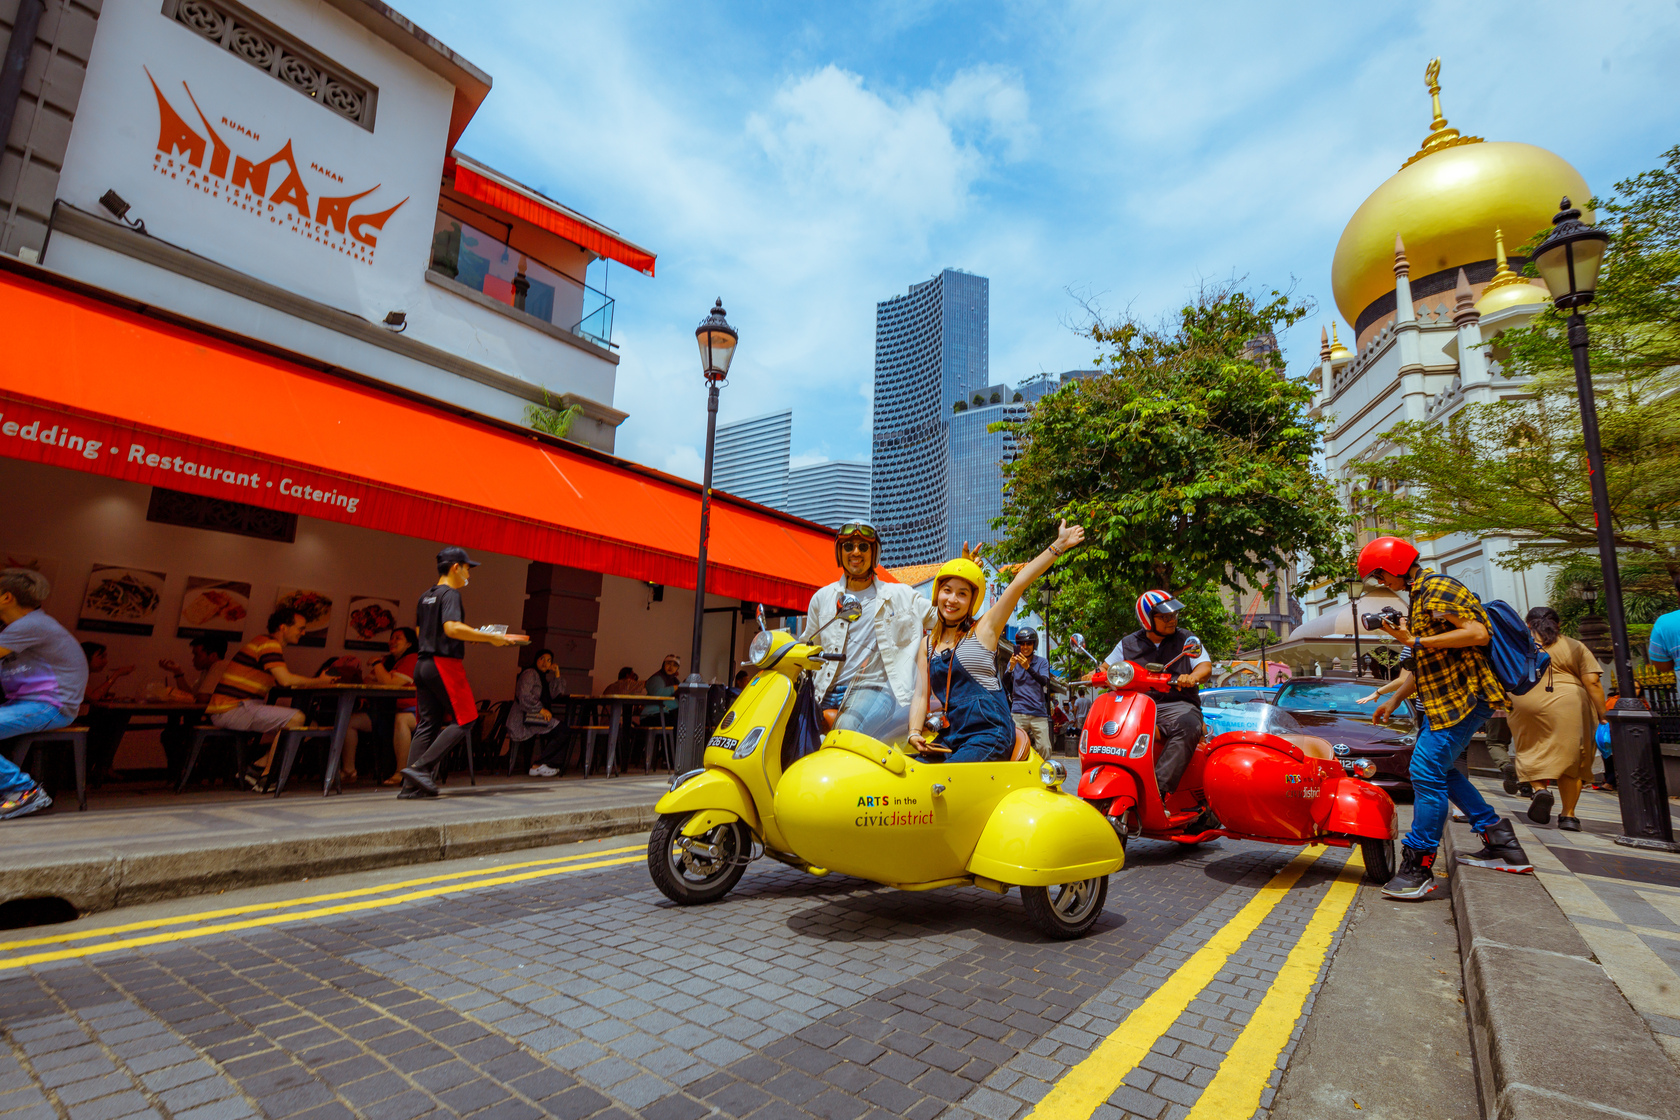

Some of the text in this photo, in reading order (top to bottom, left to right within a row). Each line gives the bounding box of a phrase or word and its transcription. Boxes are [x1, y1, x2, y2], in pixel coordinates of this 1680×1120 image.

[143, 64, 410, 249] MINANG
[221, 116, 260, 142] RUMAH
[153, 163, 374, 266] THE TRUE TASTE OF MINANGKABAU
[154, 153, 274, 213] ESTABLISHED
[287, 213, 330, 238] SINCE
[310, 161, 344, 184] MAKAN
[0, 413, 360, 513] edding Restaurant Catering
[856, 795, 917, 808] ARTS in the
